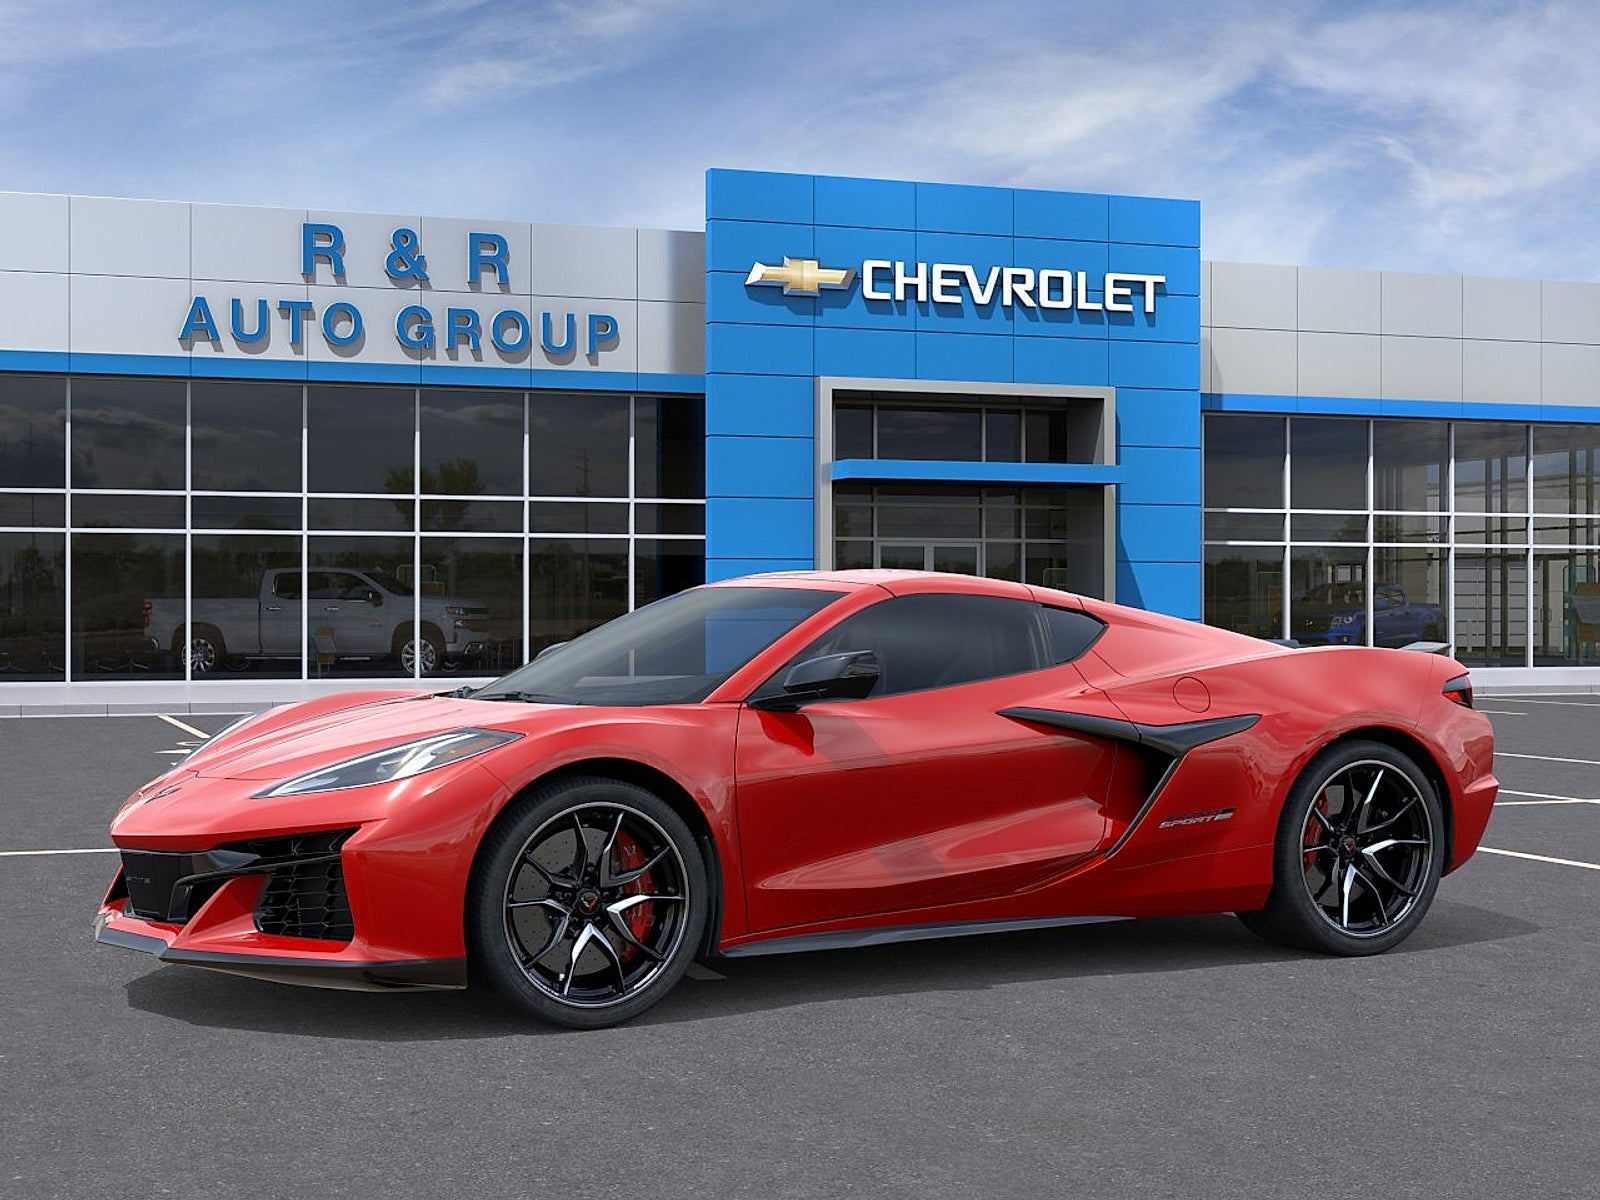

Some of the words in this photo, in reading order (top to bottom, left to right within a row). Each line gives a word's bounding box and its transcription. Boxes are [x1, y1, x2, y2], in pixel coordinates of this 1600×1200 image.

[301, 222, 346, 277] R
[384, 227, 429, 281] &
[467, 232, 510, 285] R
[862, 259, 1167, 313] CHEVROLET
[179, 295, 363, 346] AUTO
[396, 305, 620, 356] GROUP
